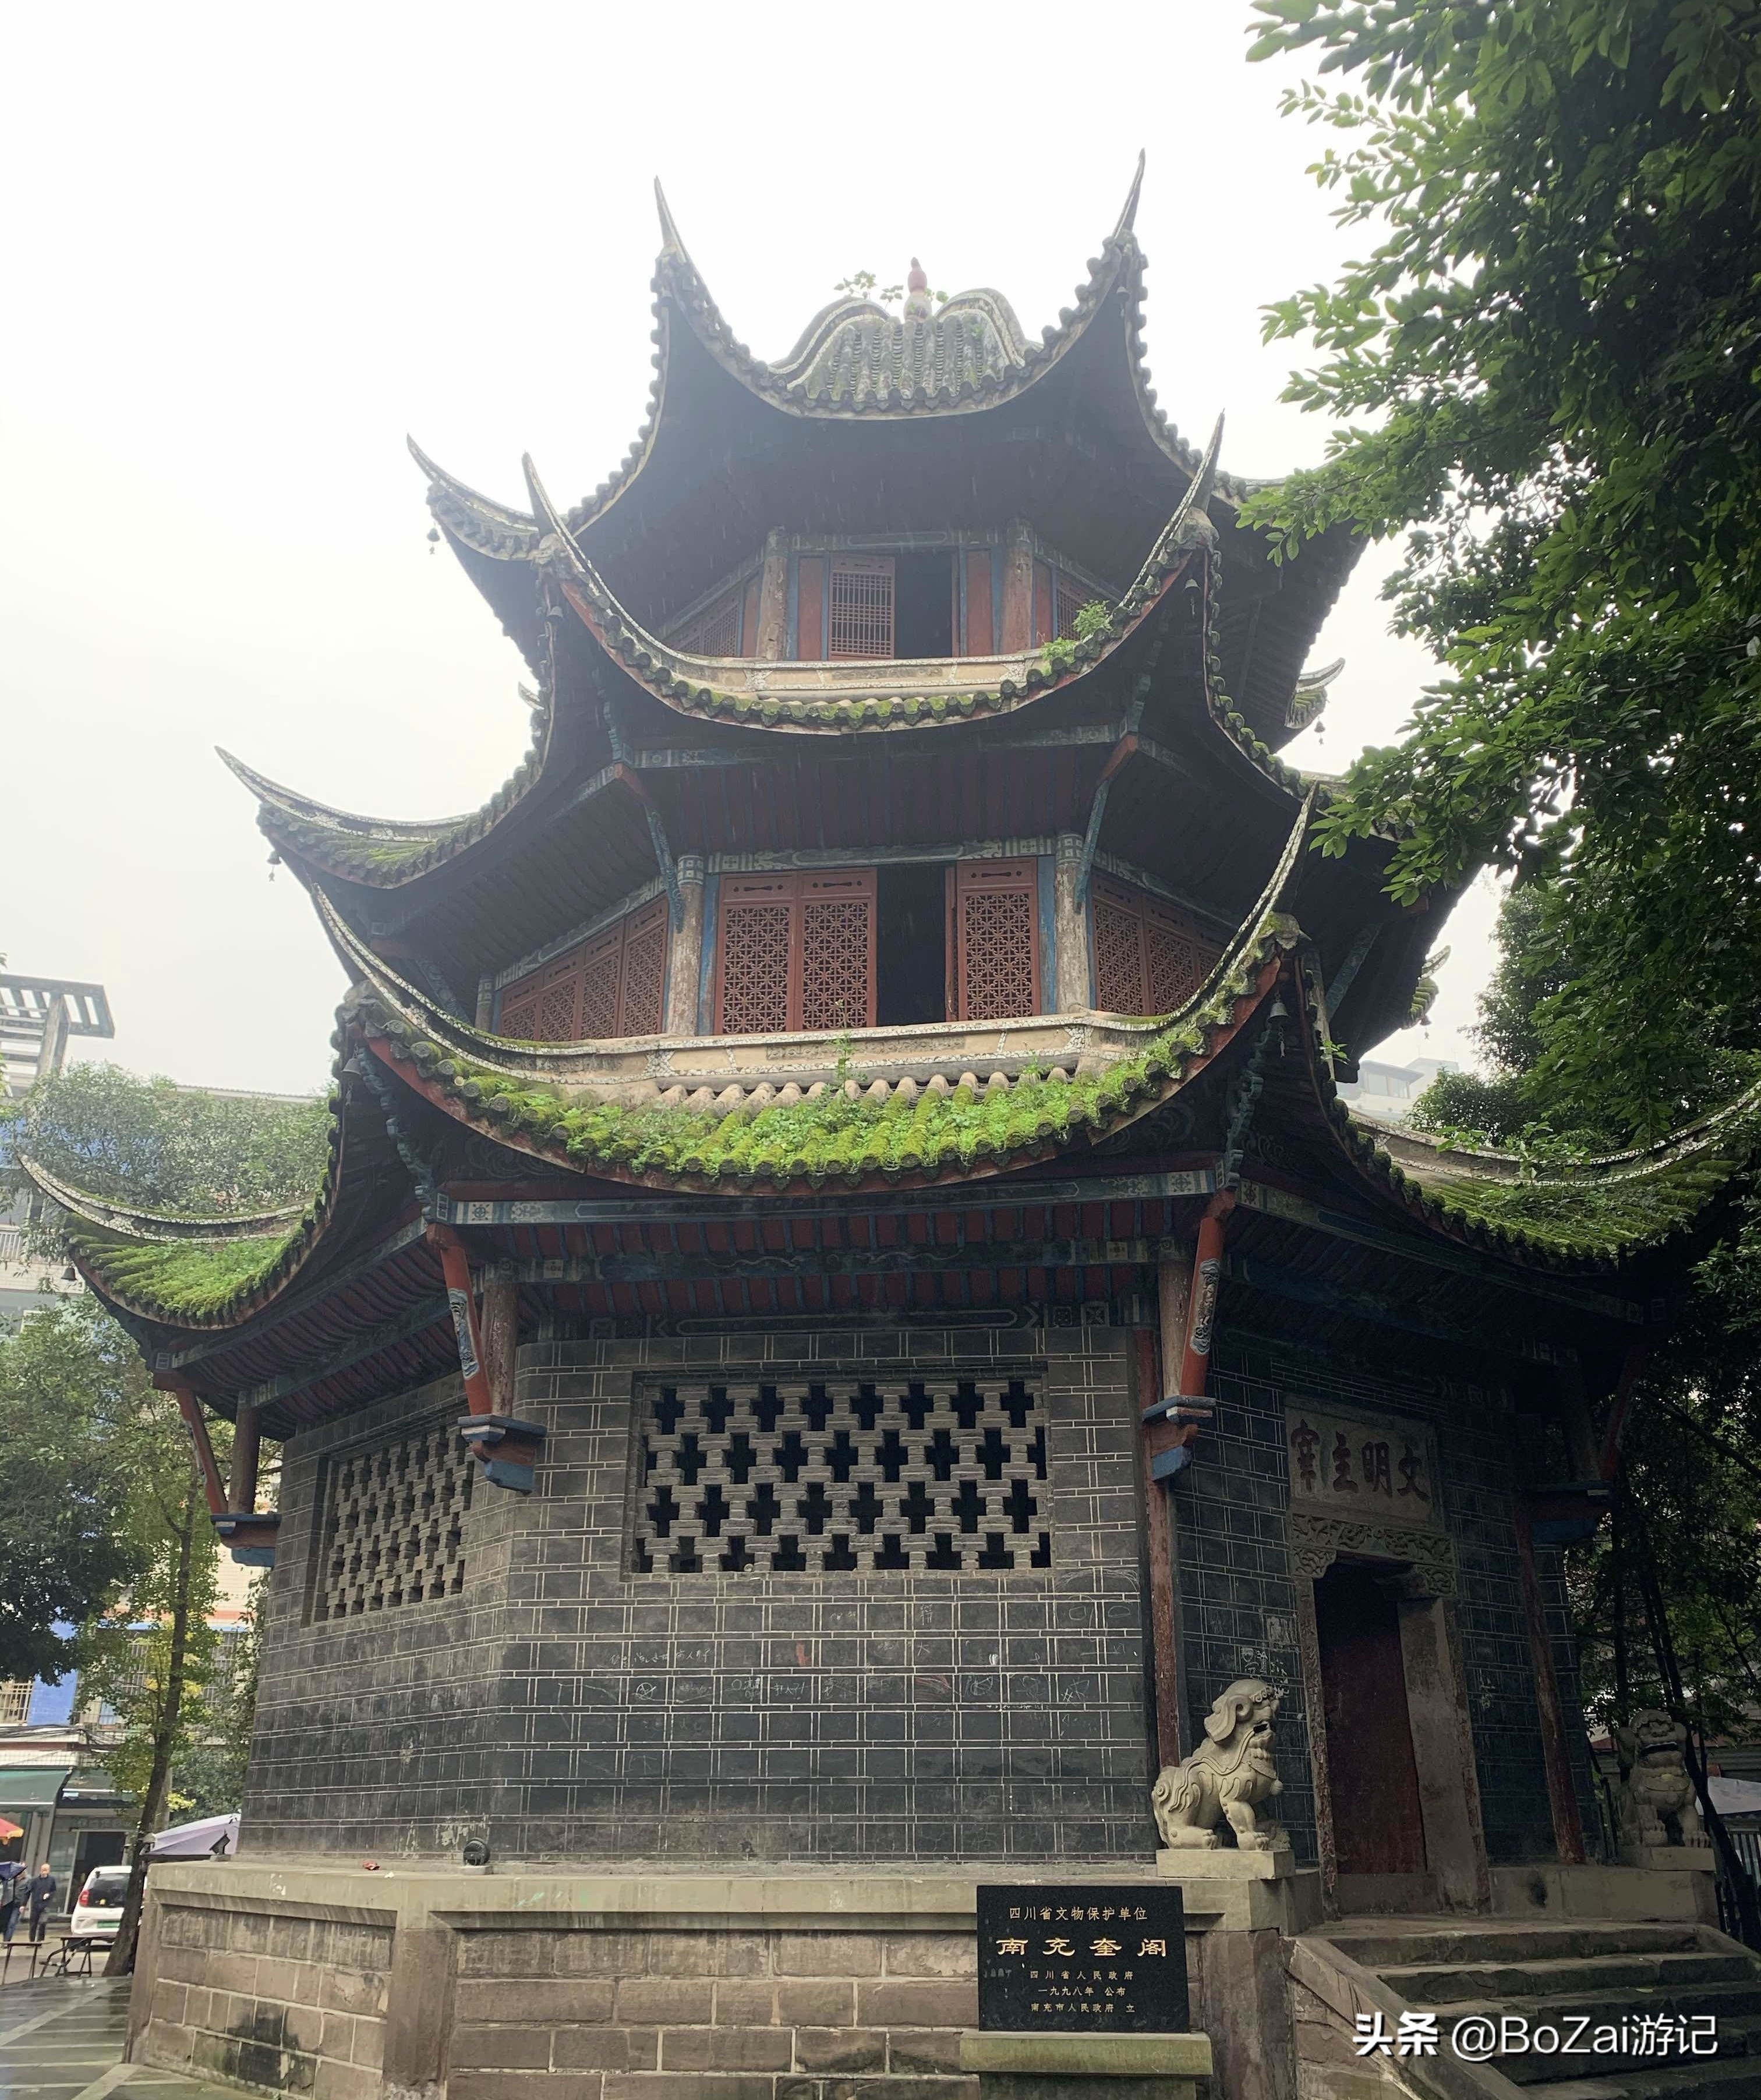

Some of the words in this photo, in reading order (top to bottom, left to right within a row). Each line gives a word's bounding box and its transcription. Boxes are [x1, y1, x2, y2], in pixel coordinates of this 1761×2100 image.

[1009, 1906, 1147, 1921] 四川省文物保护单位
[996, 1937, 1166, 1957] 南充奎阁
[1030, 1970, 1133, 1980] 四川省人民政府
[1038, 1986, 1094, 1996] 一九九八年
[1104, 1986, 1126, 1997] 公布
[1031, 2002, 1114, 2013] 南充市人民政府
[1126, 2003, 1135, 2013] 立
